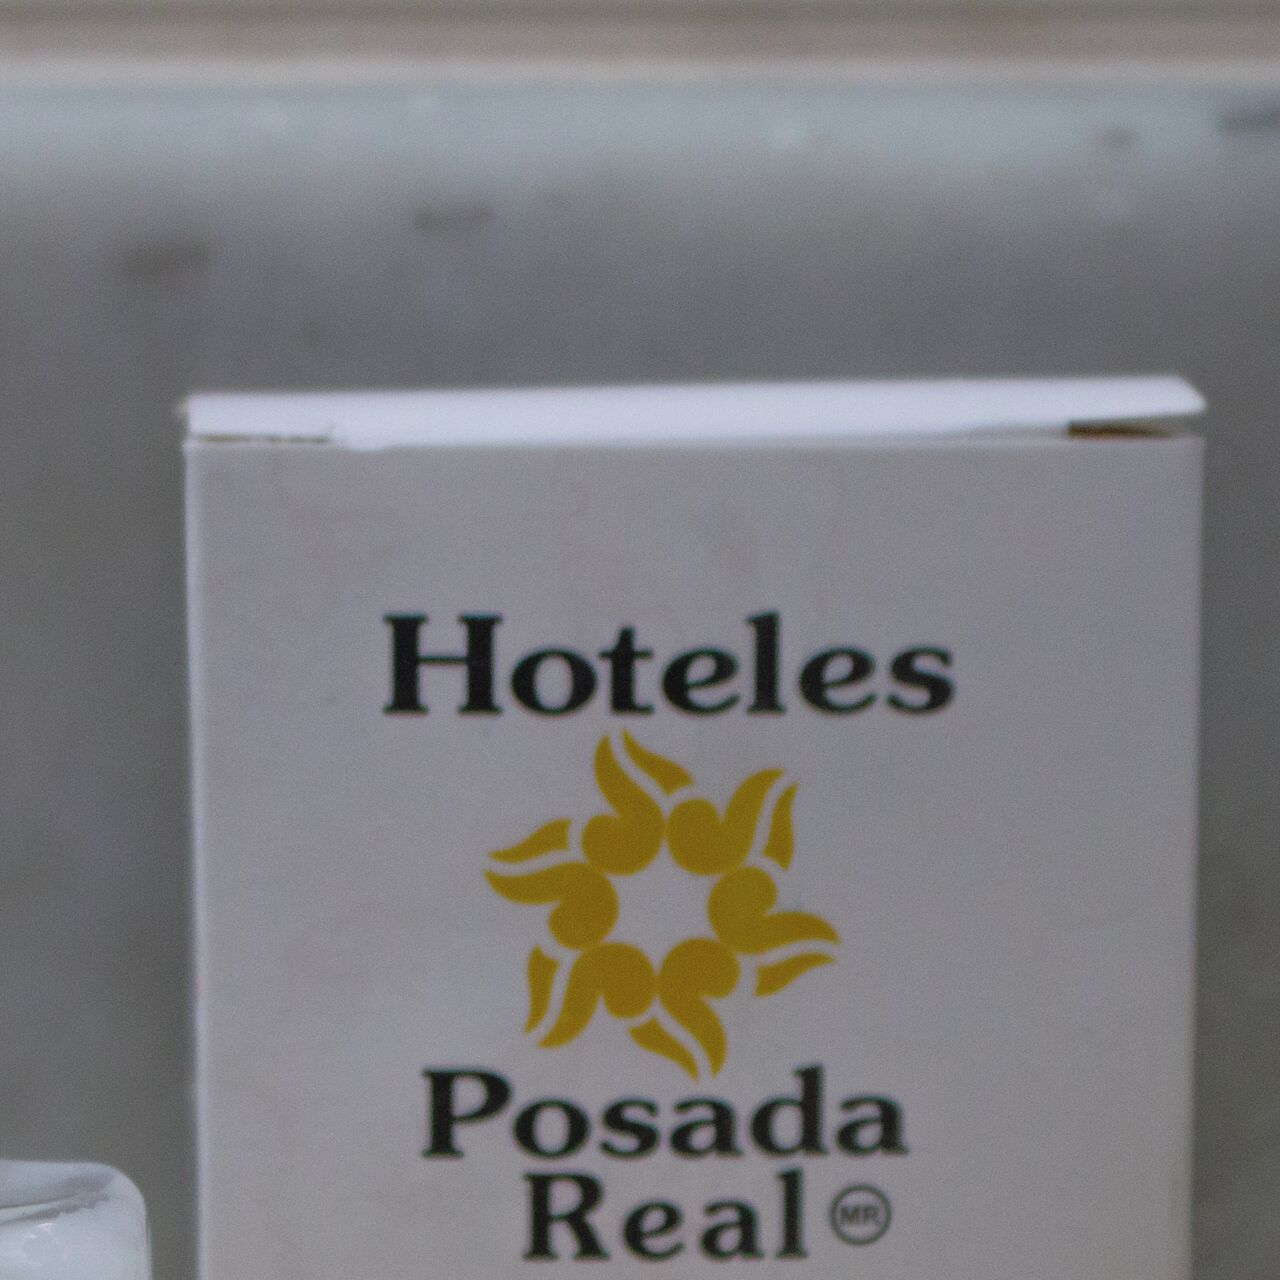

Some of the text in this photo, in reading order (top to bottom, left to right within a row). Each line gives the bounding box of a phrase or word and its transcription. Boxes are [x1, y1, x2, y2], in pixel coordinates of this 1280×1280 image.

[385, 612, 955, 717] Hoteles
[424, 1065, 908, 1159] Posada
[525, 1168, 805, 1261] Real
